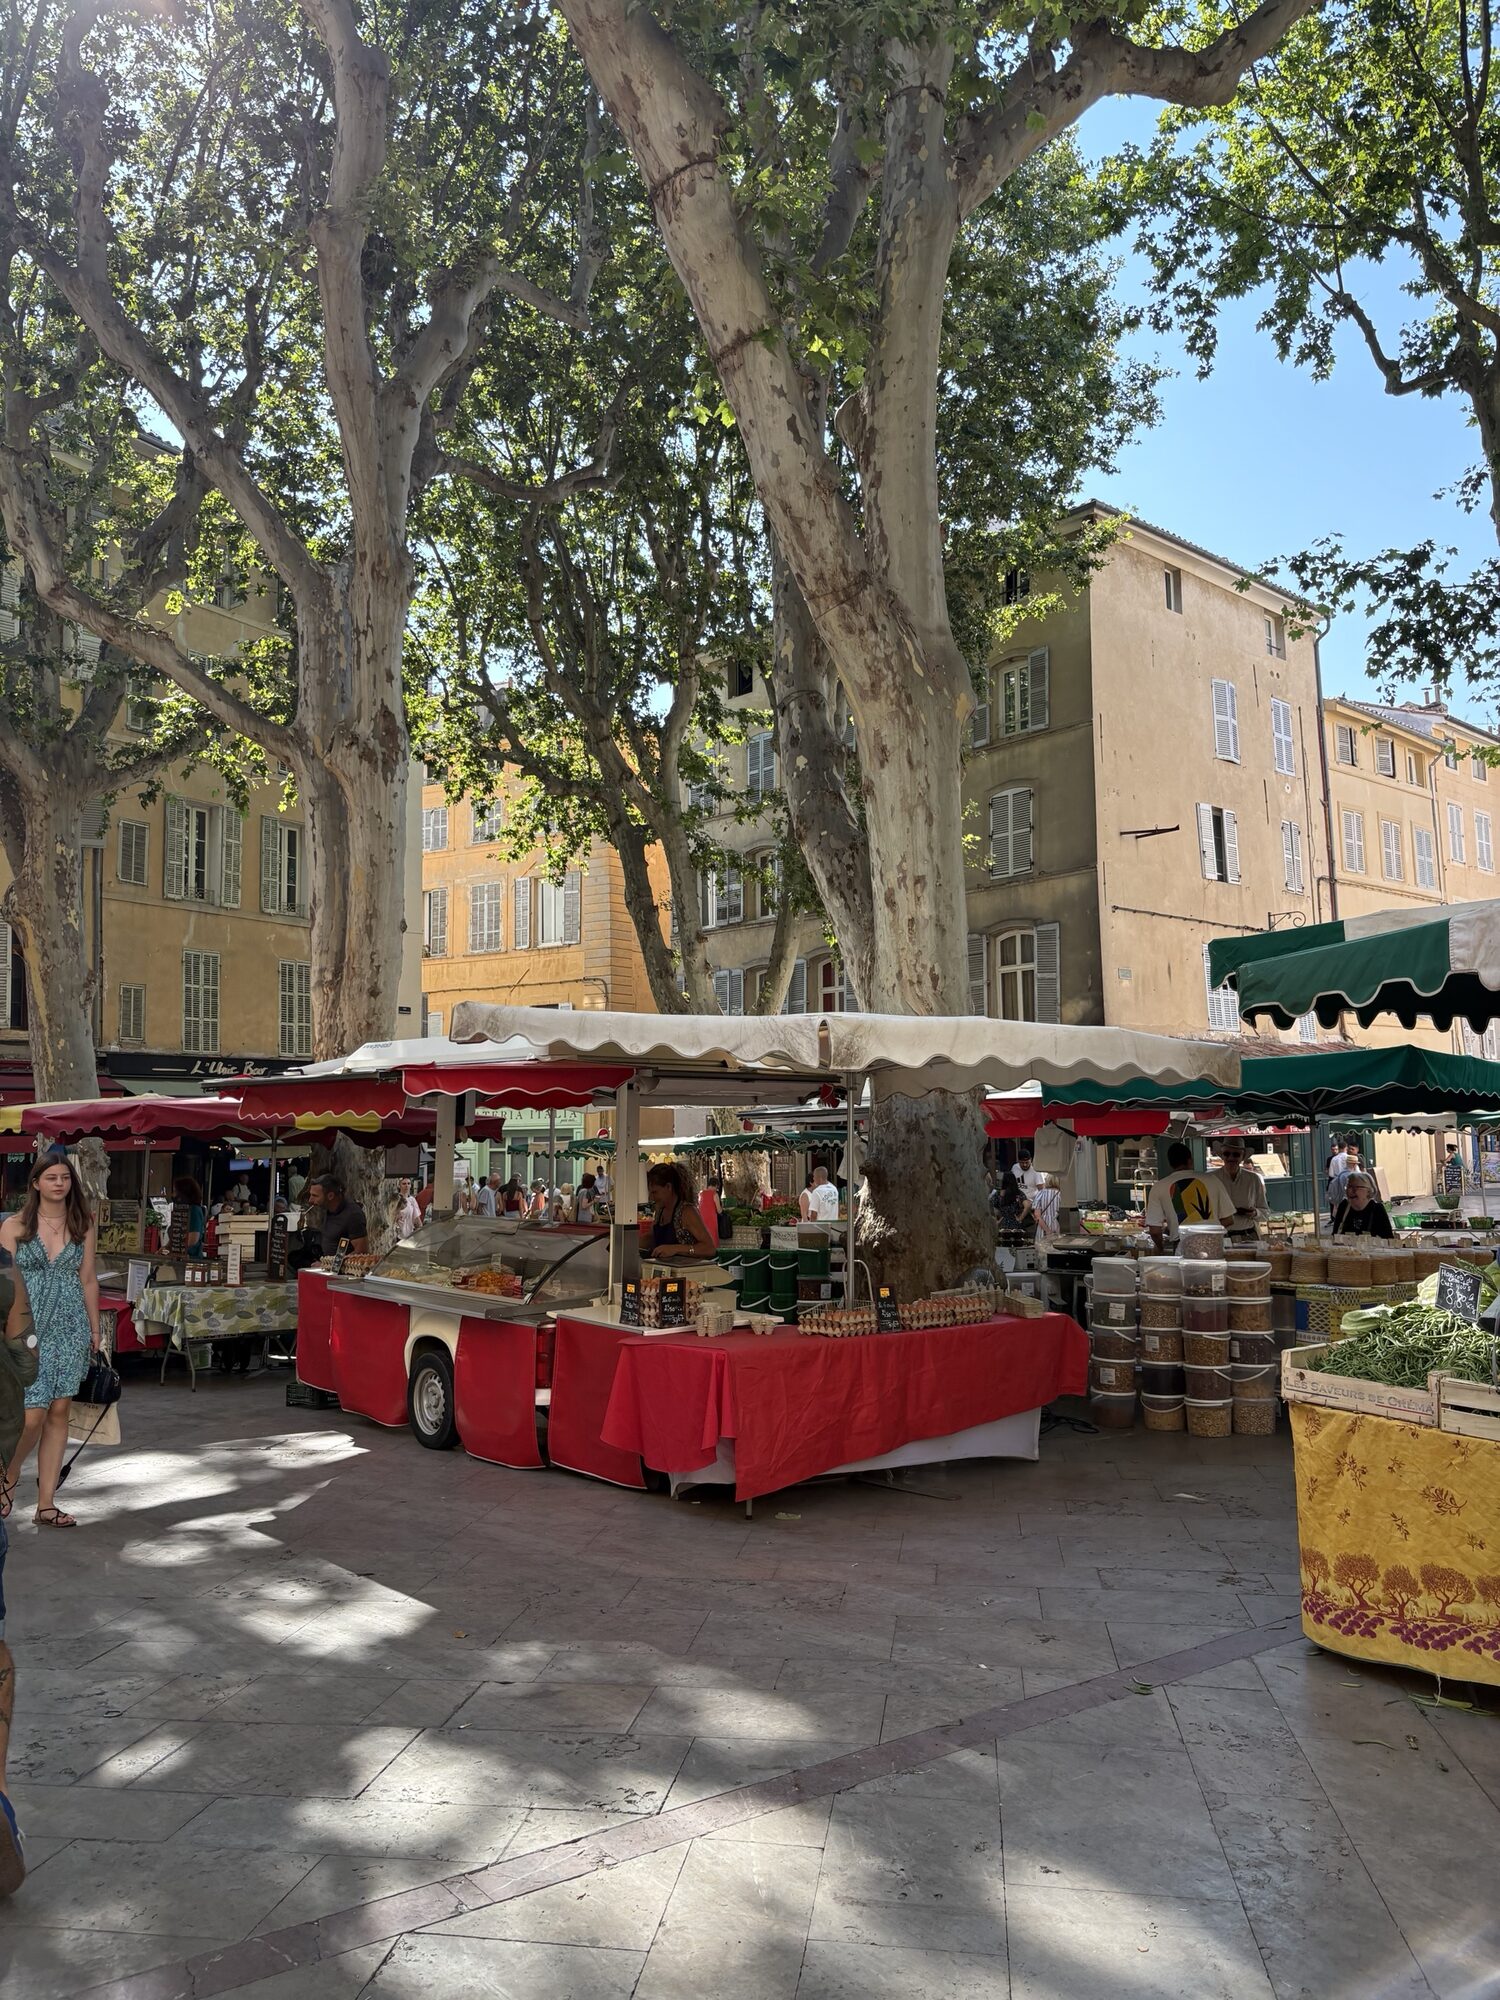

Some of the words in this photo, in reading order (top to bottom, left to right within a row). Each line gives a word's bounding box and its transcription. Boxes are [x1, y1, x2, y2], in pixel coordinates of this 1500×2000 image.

[243, 1061, 268, 1075] Bar
[1285, 1377, 1308, 1390] LES
[1311, 1382, 1365, 1400] SAVEURS
[1367, 1394, 1385, 1404] DE
